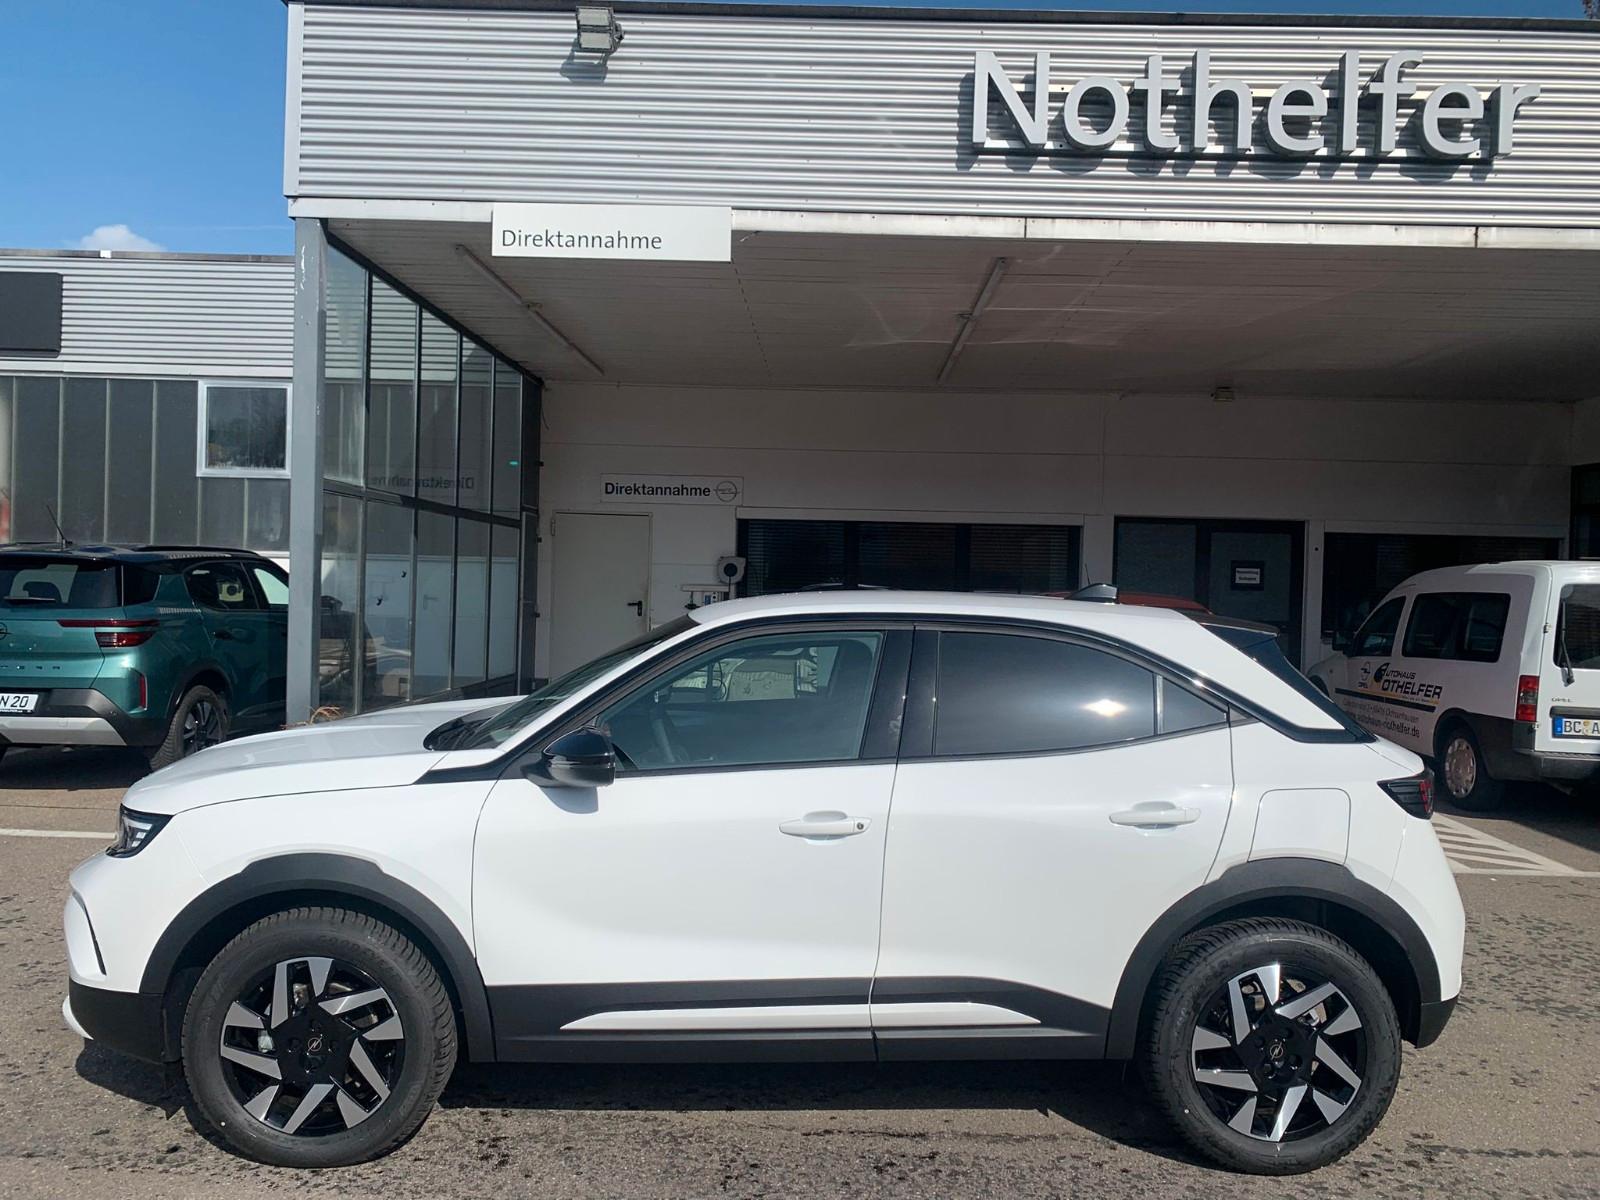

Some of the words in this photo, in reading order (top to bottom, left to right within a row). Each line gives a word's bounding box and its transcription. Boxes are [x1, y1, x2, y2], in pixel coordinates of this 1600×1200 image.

[972, 48, 1541, 158] Nothelfer
[502, 229, 662, 250] Direktannahme
[604, 482, 711, 497] Direktannahme
[11, 696, 29, 708] 20
[1564, 721, 1582, 733] BC
